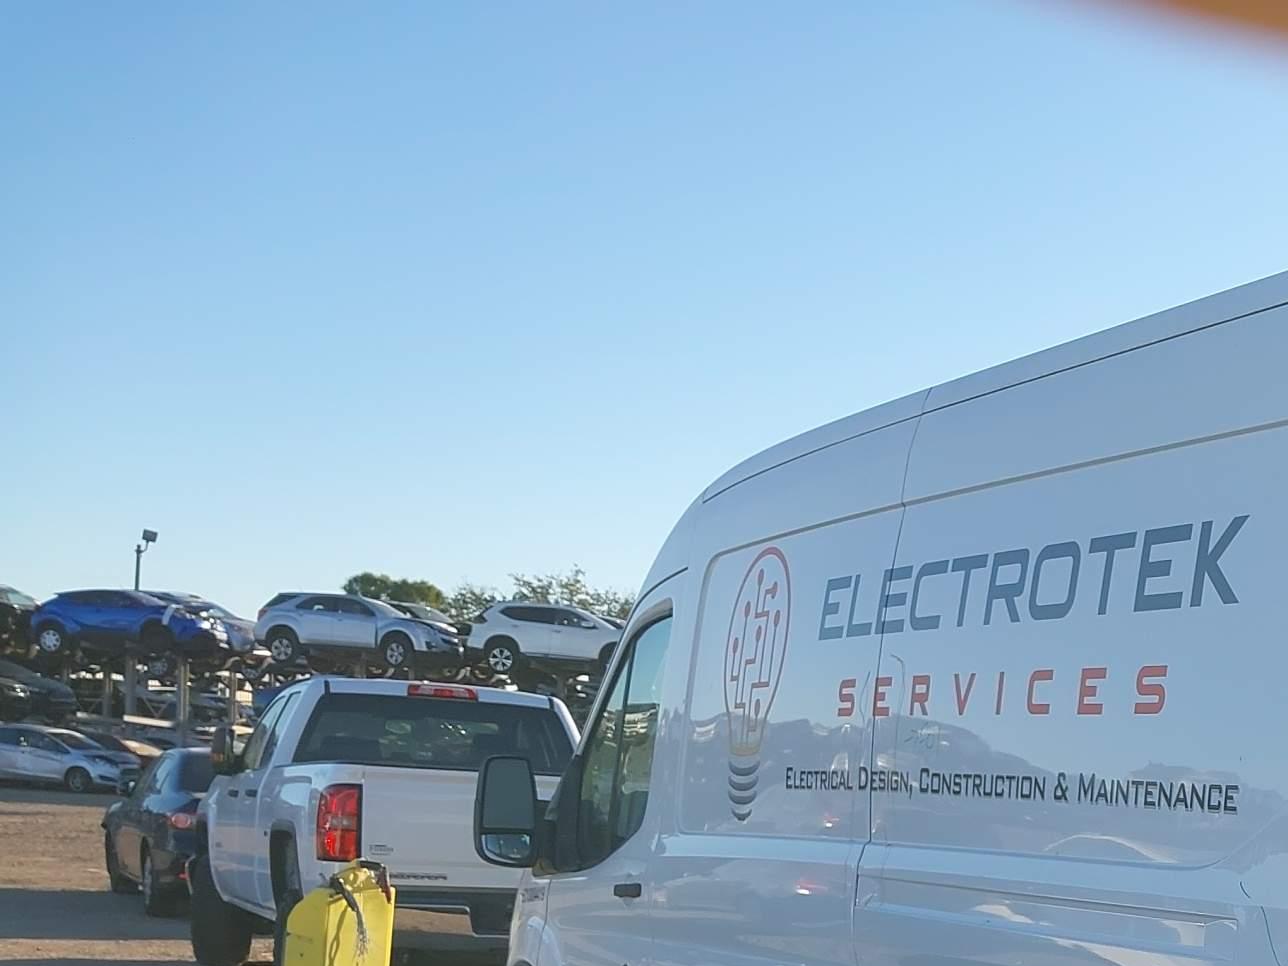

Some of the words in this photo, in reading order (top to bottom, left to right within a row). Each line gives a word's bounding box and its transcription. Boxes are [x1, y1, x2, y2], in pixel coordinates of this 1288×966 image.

[818, 515, 1250, 640] ELECTROTEK
[837, 665, 1168, 717] SERVICES
[785, 767, 853, 790] ELECTRICAL
[858, 768, 913, 799] DESIGN,
[919, 768, 1046, 800] CONSTRUCTION
[1053, 772, 1069, 801] &
[1078, 772, 1239, 814] MAINTENANCE
